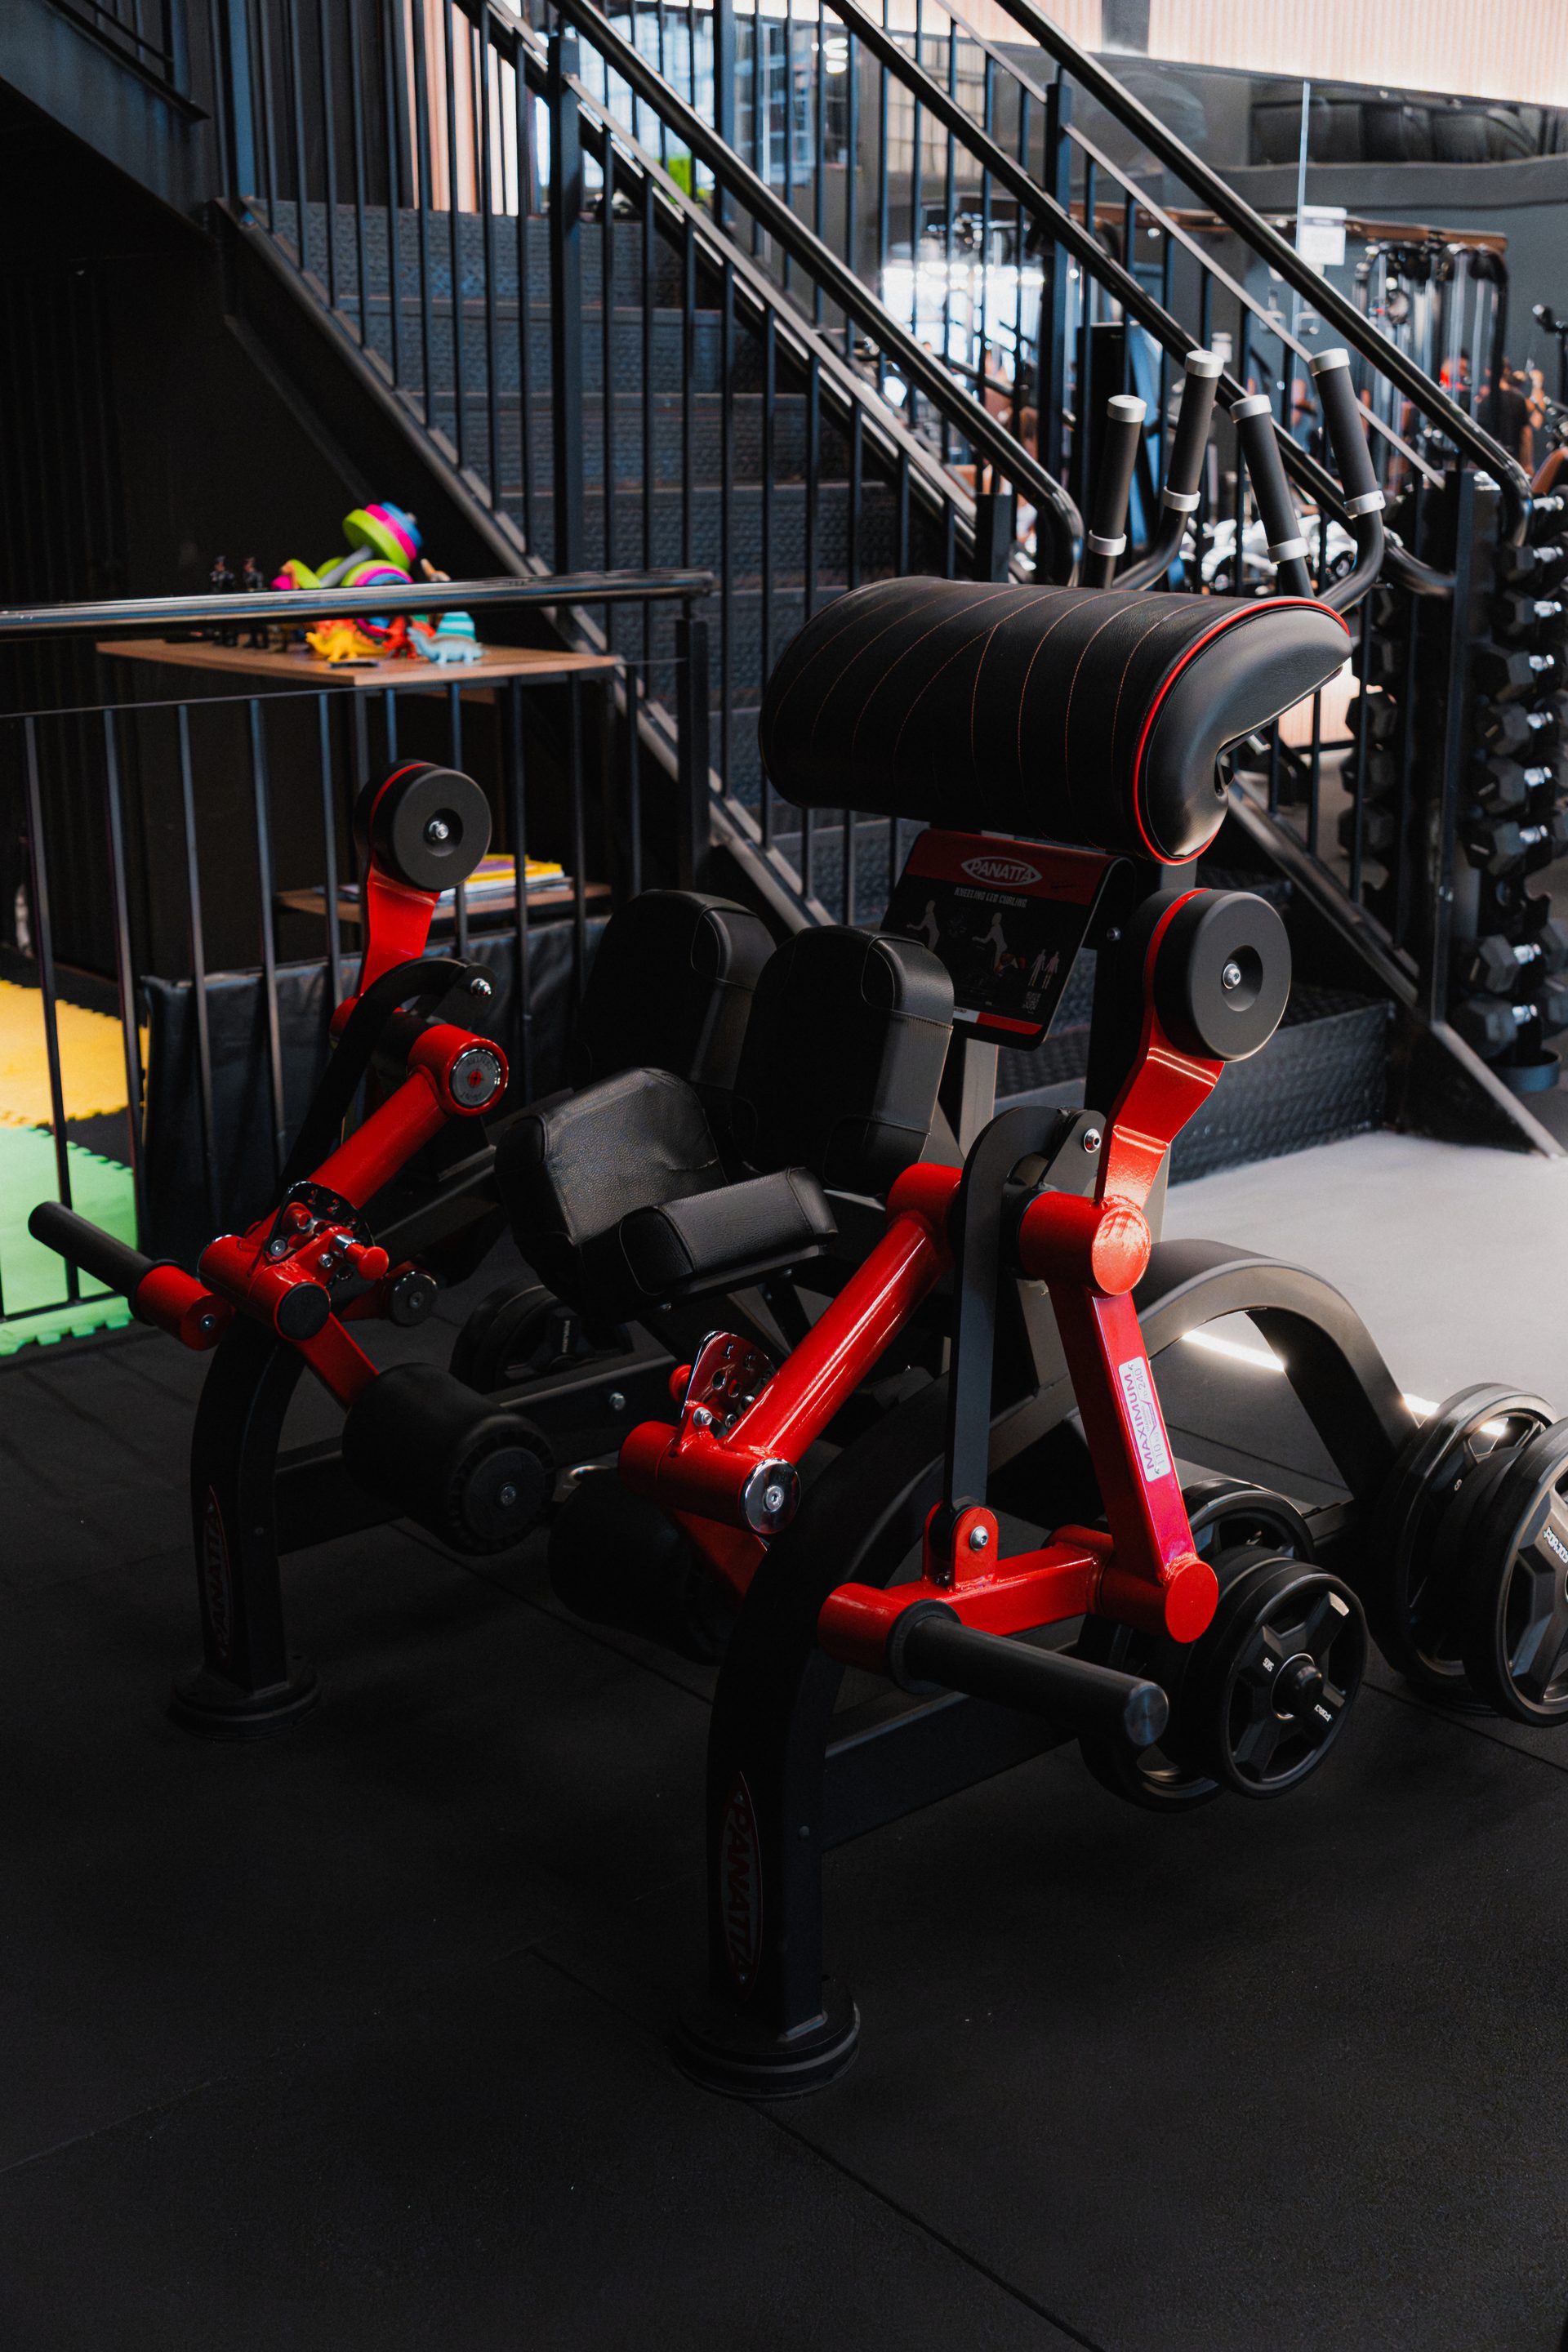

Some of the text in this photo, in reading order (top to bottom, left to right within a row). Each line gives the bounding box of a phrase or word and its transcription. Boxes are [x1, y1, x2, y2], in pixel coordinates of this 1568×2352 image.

[969, 859, 1036, 882] PANATTA
[1134, 1368, 1147, 1391] 240
[1124, 1374, 1155, 1470] MAXIMUM
[1153, 1443, 1165, 1465] 110
